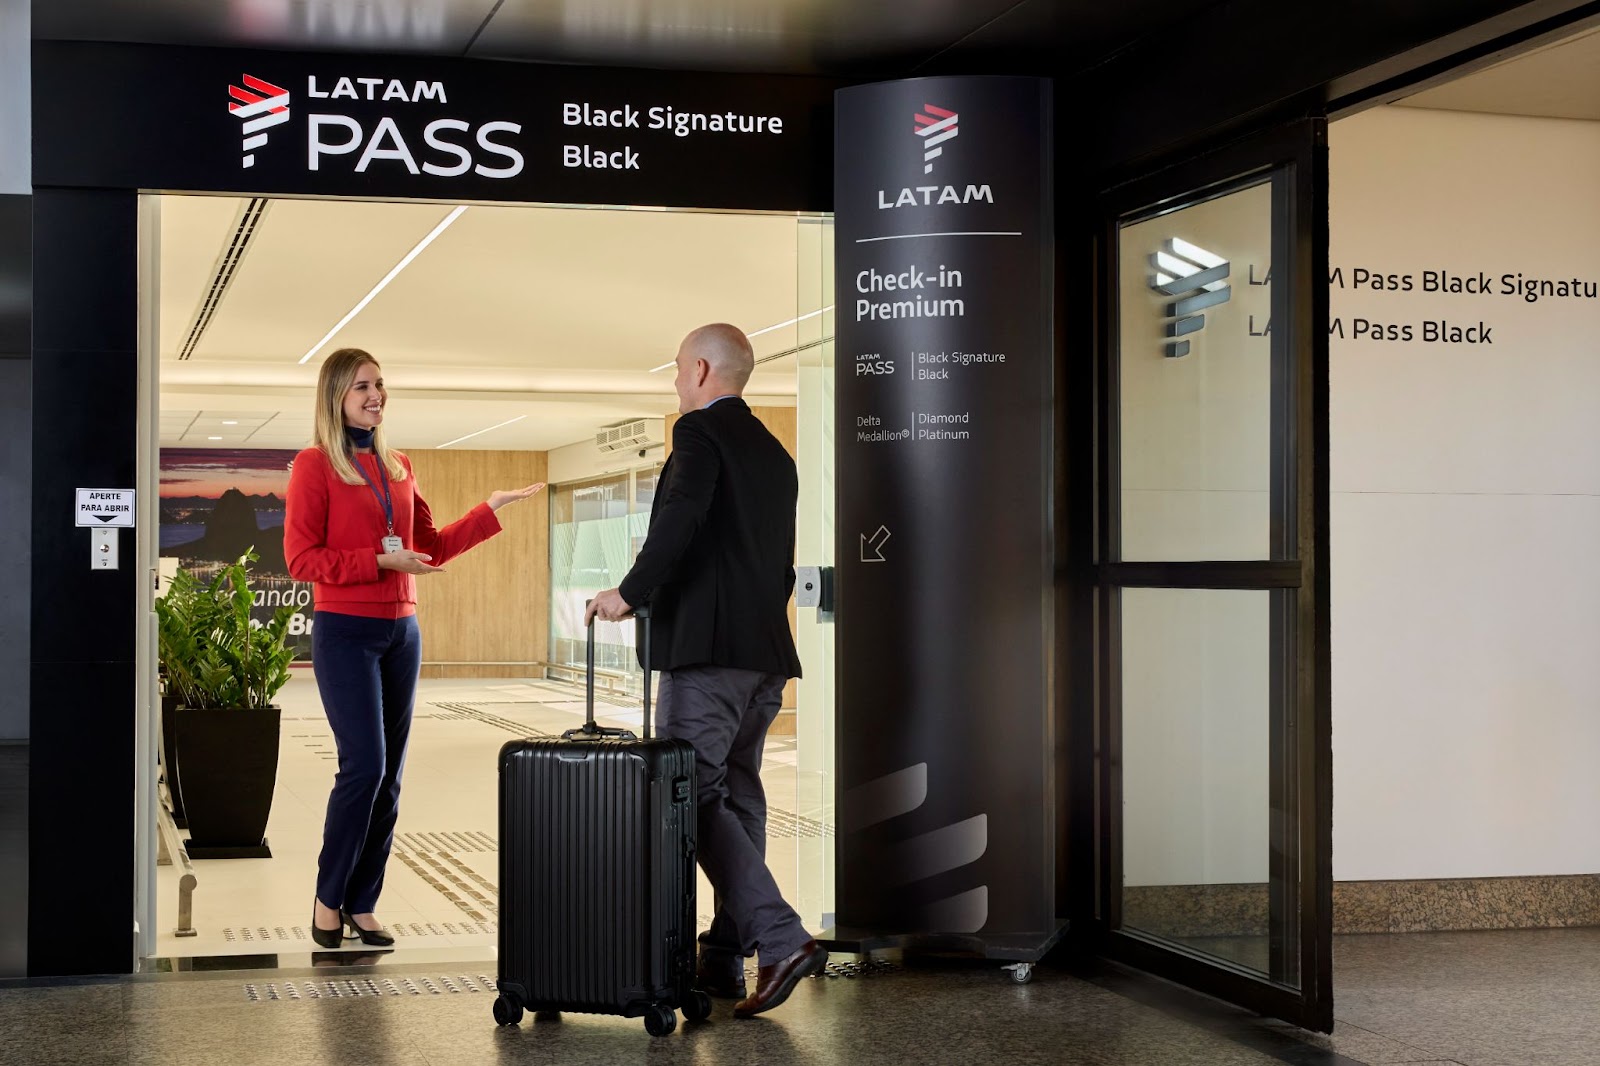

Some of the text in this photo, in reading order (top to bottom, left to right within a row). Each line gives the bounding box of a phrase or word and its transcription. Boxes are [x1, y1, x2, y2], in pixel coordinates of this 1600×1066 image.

[308, 75, 447, 103] LATAM
[563, 102, 783, 137] Black Signature
[308, 114, 525, 179] PASS
[563, 144, 640, 170] Black
[878, 185, 994, 209] LATAM
[856, 265, 962, 293] Check-in
[1353, 268, 1413, 291] Pass
[1423, 270, 1492, 294] Black
[1500, 273, 1597, 303] Signatu
[856, 295, 964, 322] Premium
[1353, 318, 1413, 341] Pass
[1423, 320, 1492, 344] Black
[856, 353, 881, 361] LATAM
[918, 351, 1006, 366] Black Signature
[856, 361, 895, 376] PASS
[918, 368, 949, 380] Black
[857, 415, 881, 427] Delta
[918, 412, 969, 424] Diamond
[918, 429, 970, 440] Platinum
[89, 492, 122, 500] APERTE
[81, 504, 130, 512] PARA ABRIR
